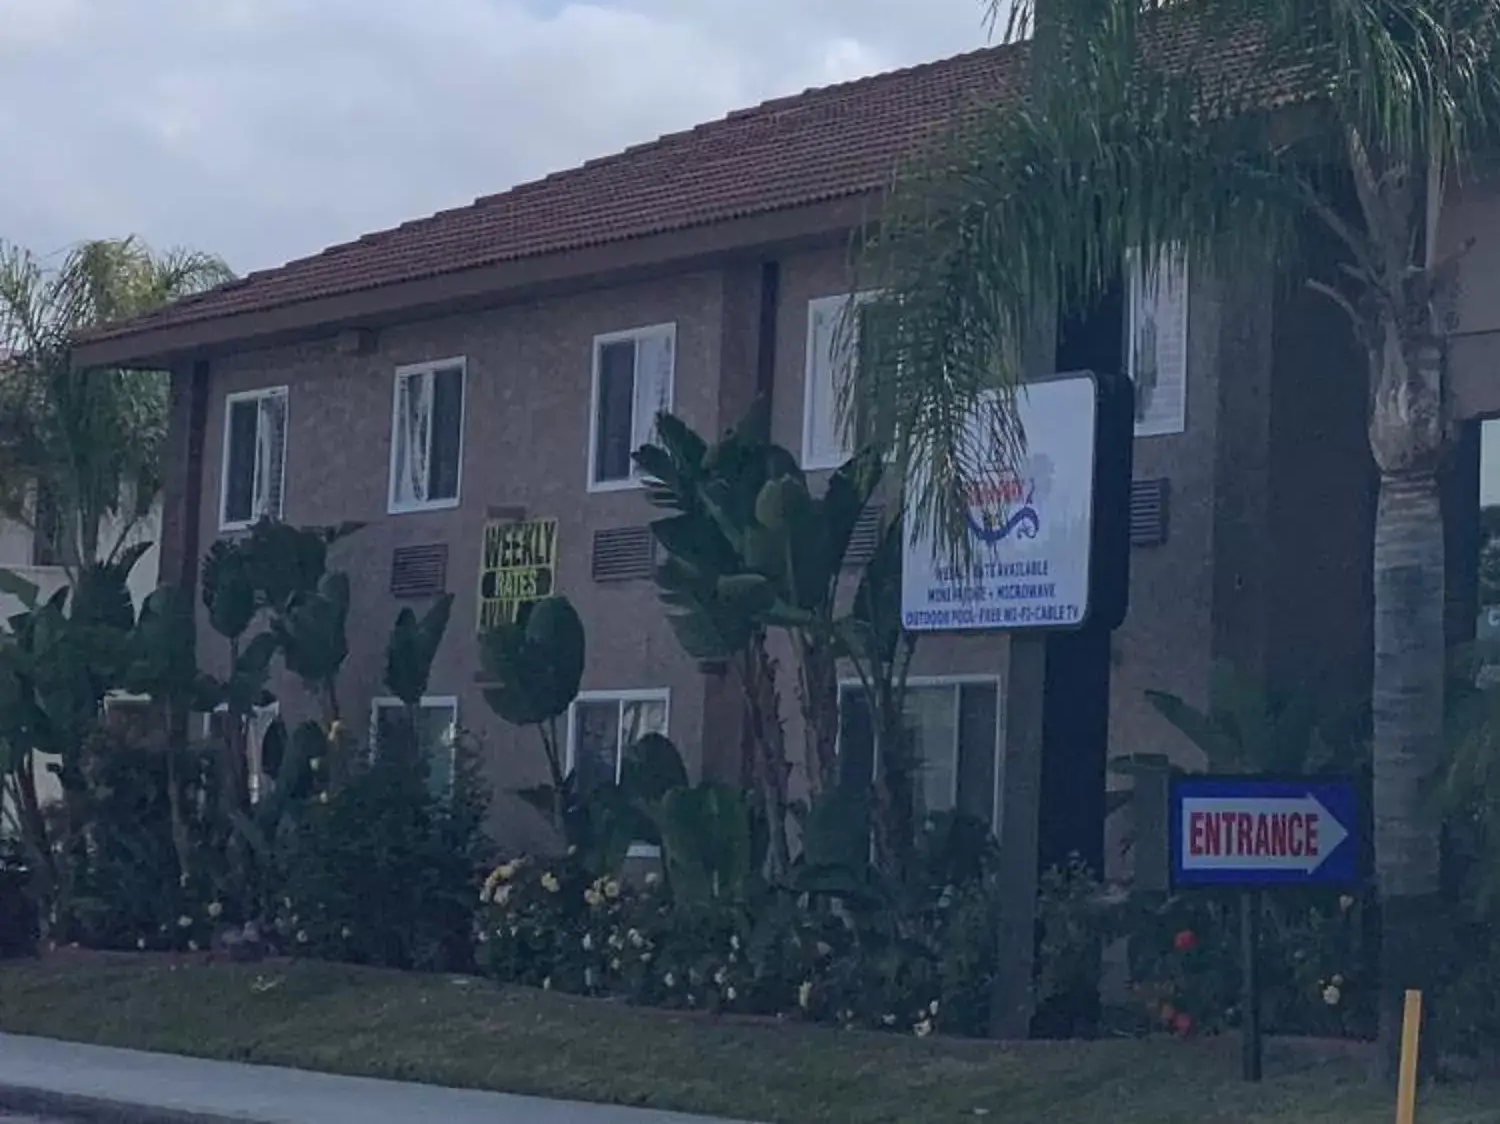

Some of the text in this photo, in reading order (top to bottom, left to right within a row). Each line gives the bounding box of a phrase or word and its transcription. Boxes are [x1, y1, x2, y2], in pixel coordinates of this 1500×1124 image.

[485, 521, 556, 569] WEEKLY
[997, 559, 1049, 577] AVAILABLE
[495, 568, 537, 597] RATES
[997, 582, 1056, 600] MICROWAVE
[905, 610, 950, 626] OUTDOOR
[1066, 604, 1079, 620] TV
[1189, 812, 1321, 857] ENTRANCE
